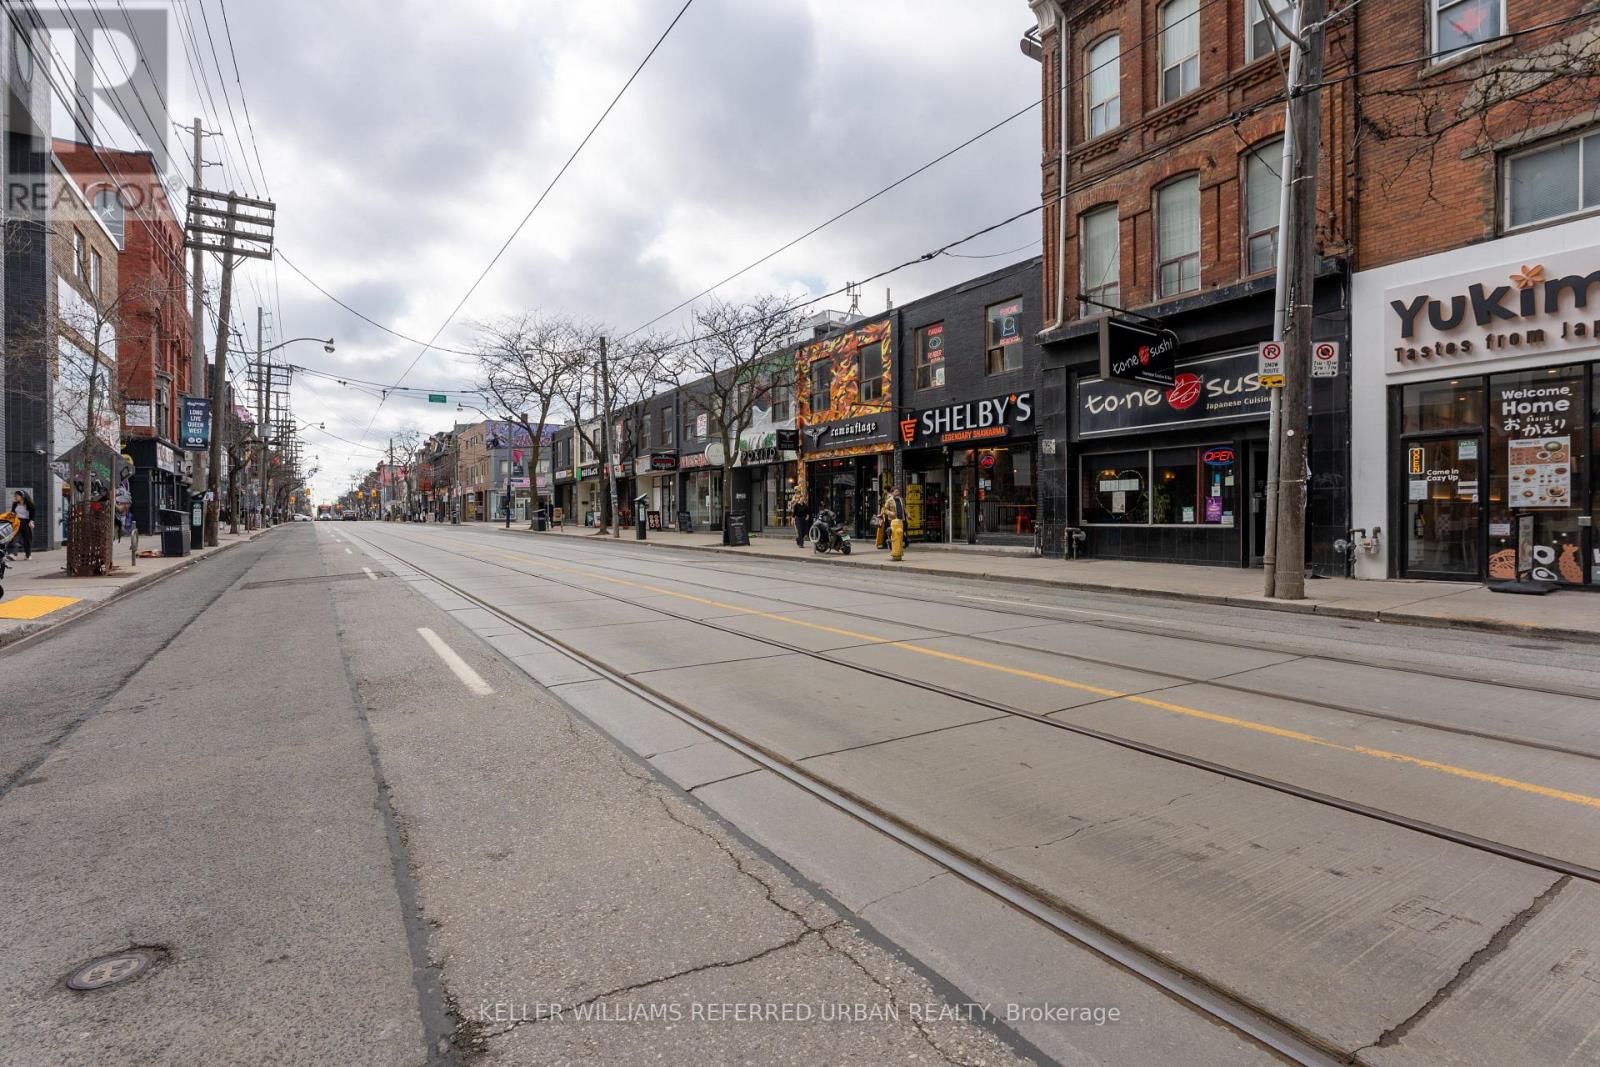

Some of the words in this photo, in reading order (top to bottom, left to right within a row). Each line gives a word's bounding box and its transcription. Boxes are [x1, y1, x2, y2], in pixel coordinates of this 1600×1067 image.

[1150, 338, 1173, 357] sushi
[1394, 340, 1472, 362] Tastes
[1485, 329, 1545, 349] from
[1501, 387, 1570, 400] Welcome
[1205, 399, 1242, 411] Japanese
[1502, 399, 1570, 415] Home
[922, 393, 1030, 436] SHELBY'S
[1503, 418, 1566, 437] おかえり
[941, 431, 972, 442] LEGENDARY
[1204, 451, 1235, 461] OPEN
